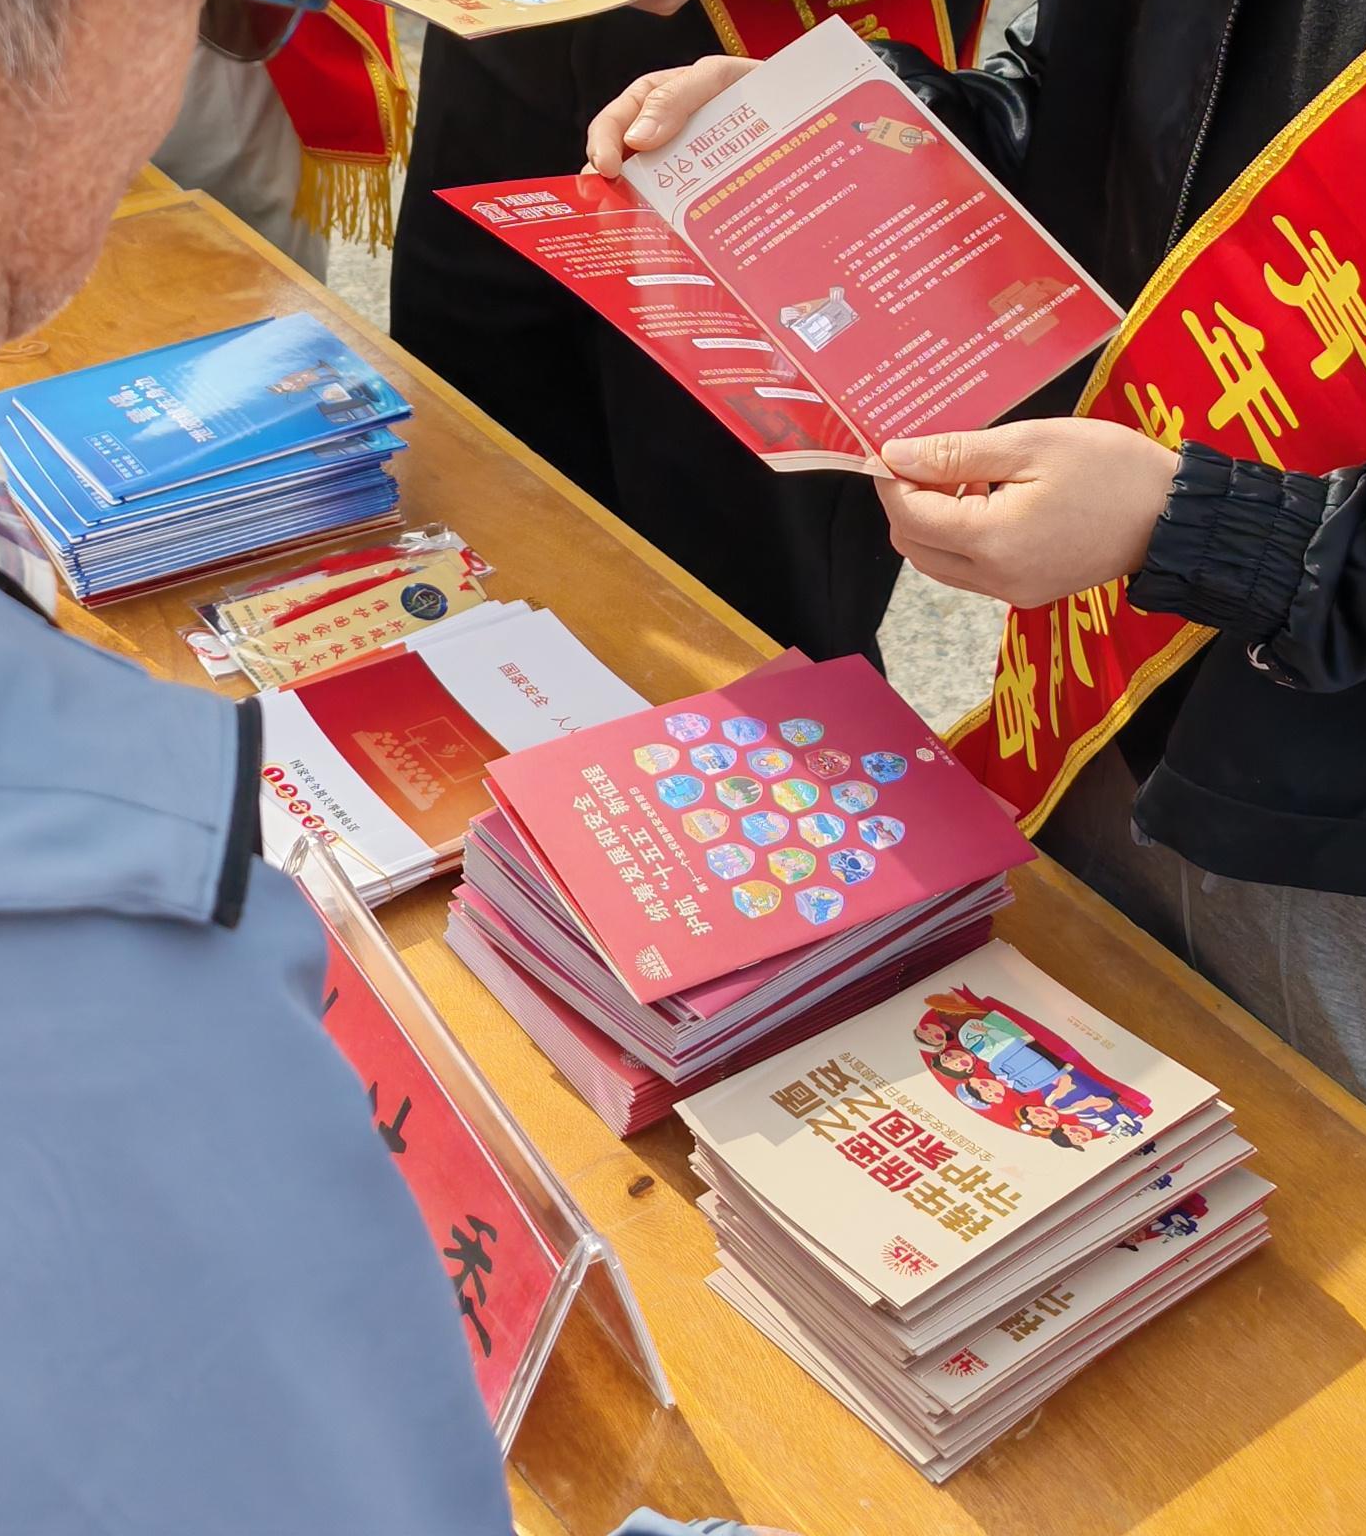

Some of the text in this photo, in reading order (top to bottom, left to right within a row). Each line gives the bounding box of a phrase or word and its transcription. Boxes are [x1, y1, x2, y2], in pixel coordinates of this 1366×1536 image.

[499, 662, 550, 708] 国家安全
[291, 759, 362, 833] 国家安全机关举报电话
[591, 764, 633, 817] 新征程
[572, 792, 670, 923] 统筹发展和安全
[675, 892, 714, 937] 护航
[769, 1076, 995, 1243] 铸牢保密之盾
[814, 1059, 1025, 1219] 守护家国之安
